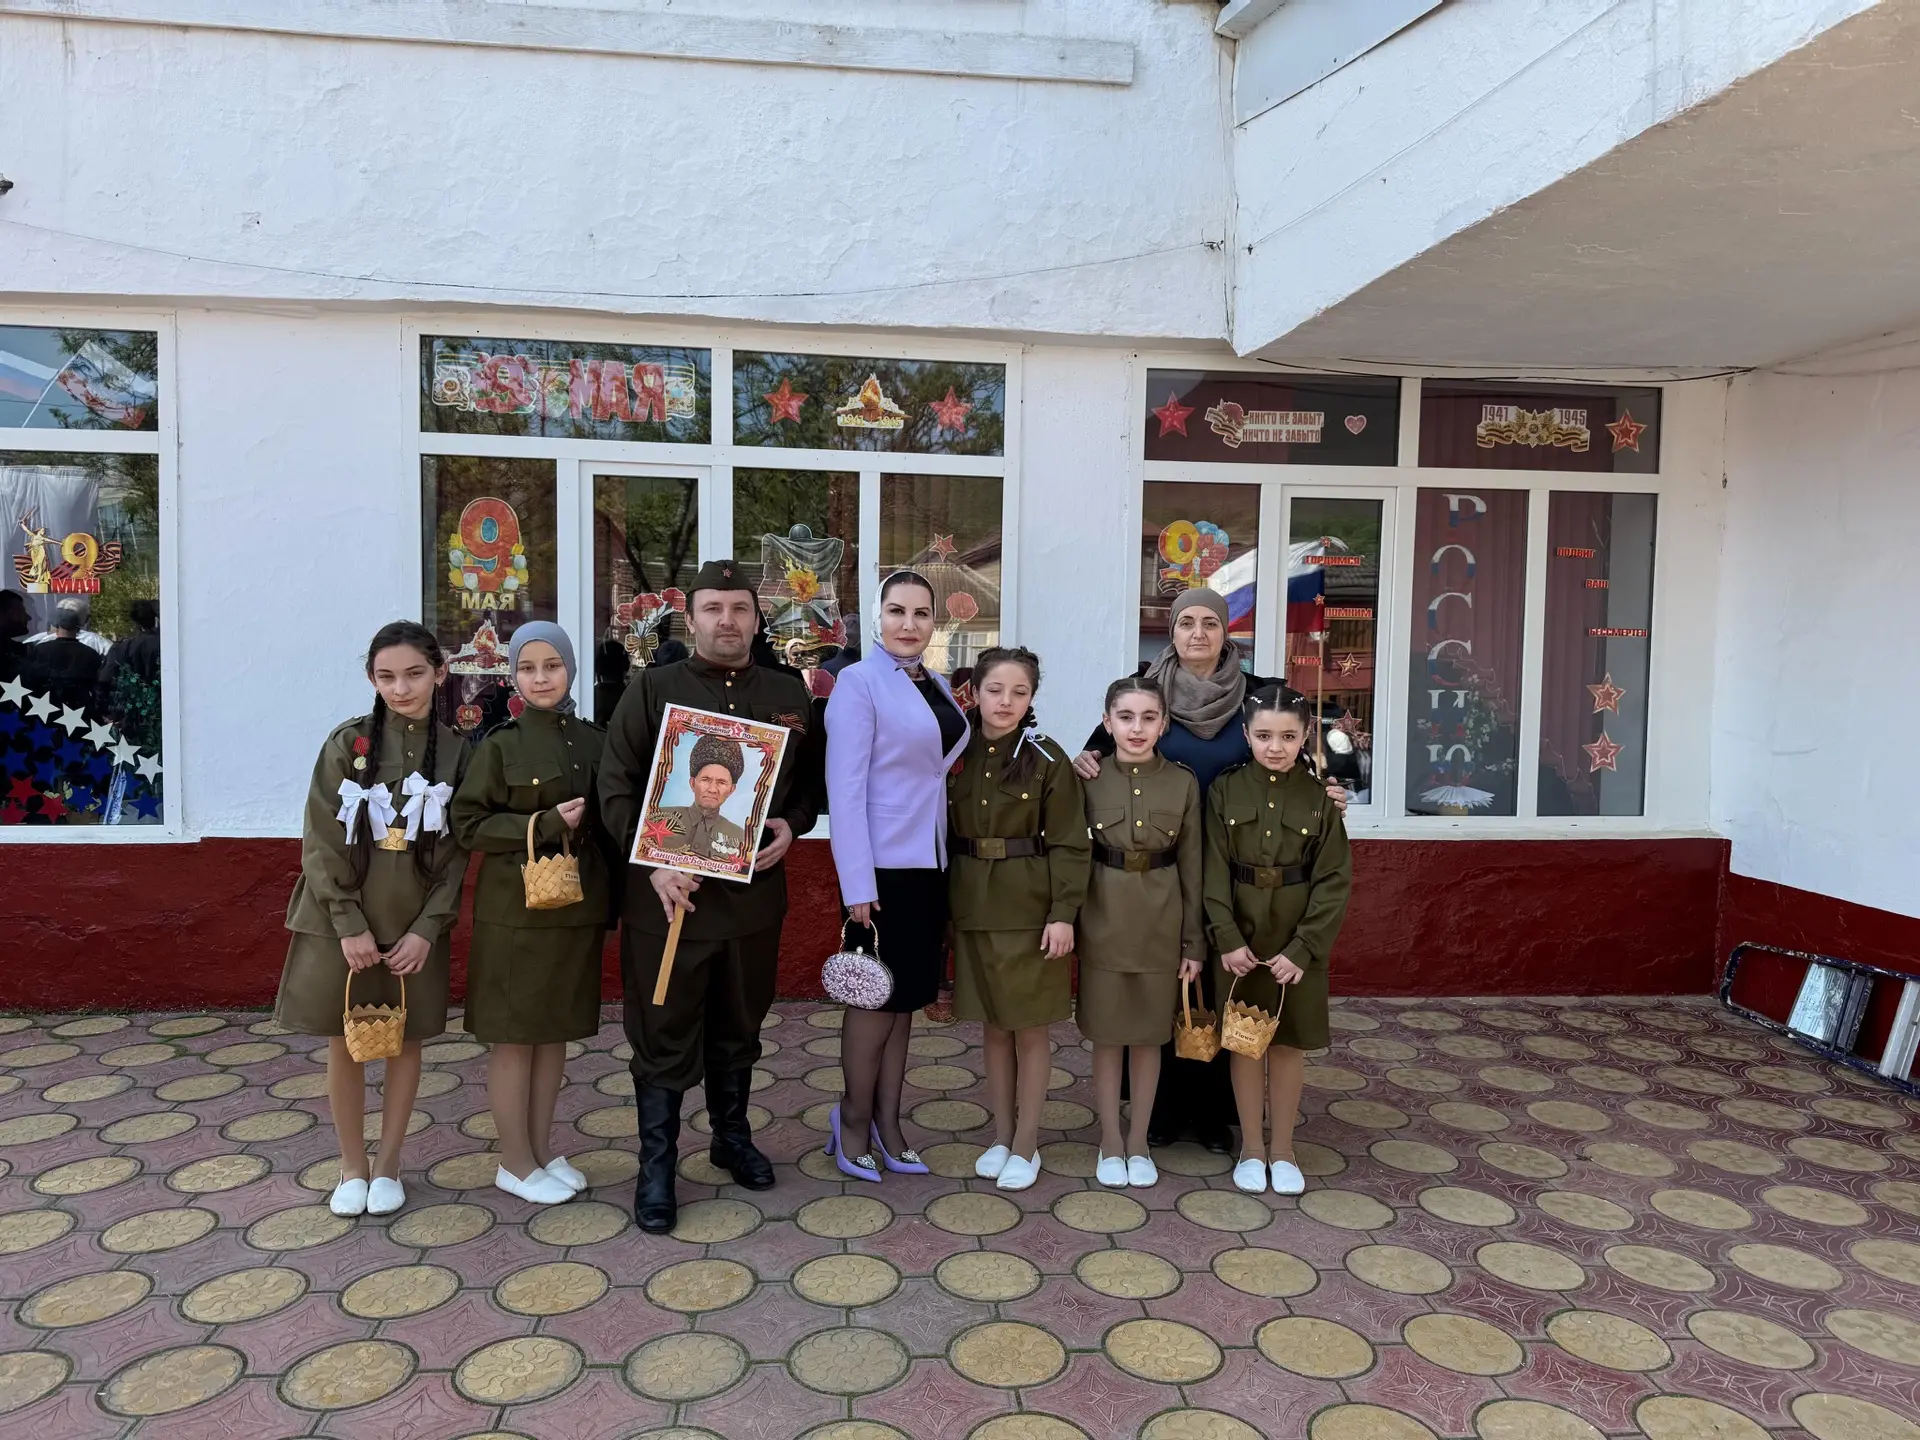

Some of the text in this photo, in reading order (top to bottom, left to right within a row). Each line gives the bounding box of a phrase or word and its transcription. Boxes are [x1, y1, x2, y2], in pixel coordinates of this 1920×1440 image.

[476, 354, 667, 423] 9 МАЯ
[840, 414, 901, 428] 1941 1945
[1249, 412, 1277, 425] НИКТО
[1279, 413, 1290, 425] НЕ
[1483, 405, 1586, 425] 1941 1945
[1243, 428, 1321, 442] НИЧТО НЕ ЗАБЫТО
[459, 496, 521, 592] 9
[61, 532, 99, 578] 9
[1306, 555, 1360, 566] ГОРДИМСЯ
[51, 577, 101, 594] МАЯ
[1586, 579, 1609, 588] ВАШ
[462, 592, 516, 611] МАЯ
[1324, 607, 1372, 618] ПОМНИМ
[494, 662, 511, 672] 19
[764, 732, 783, 742] 1945
[1235, 1030, 1255, 1043] Flower
